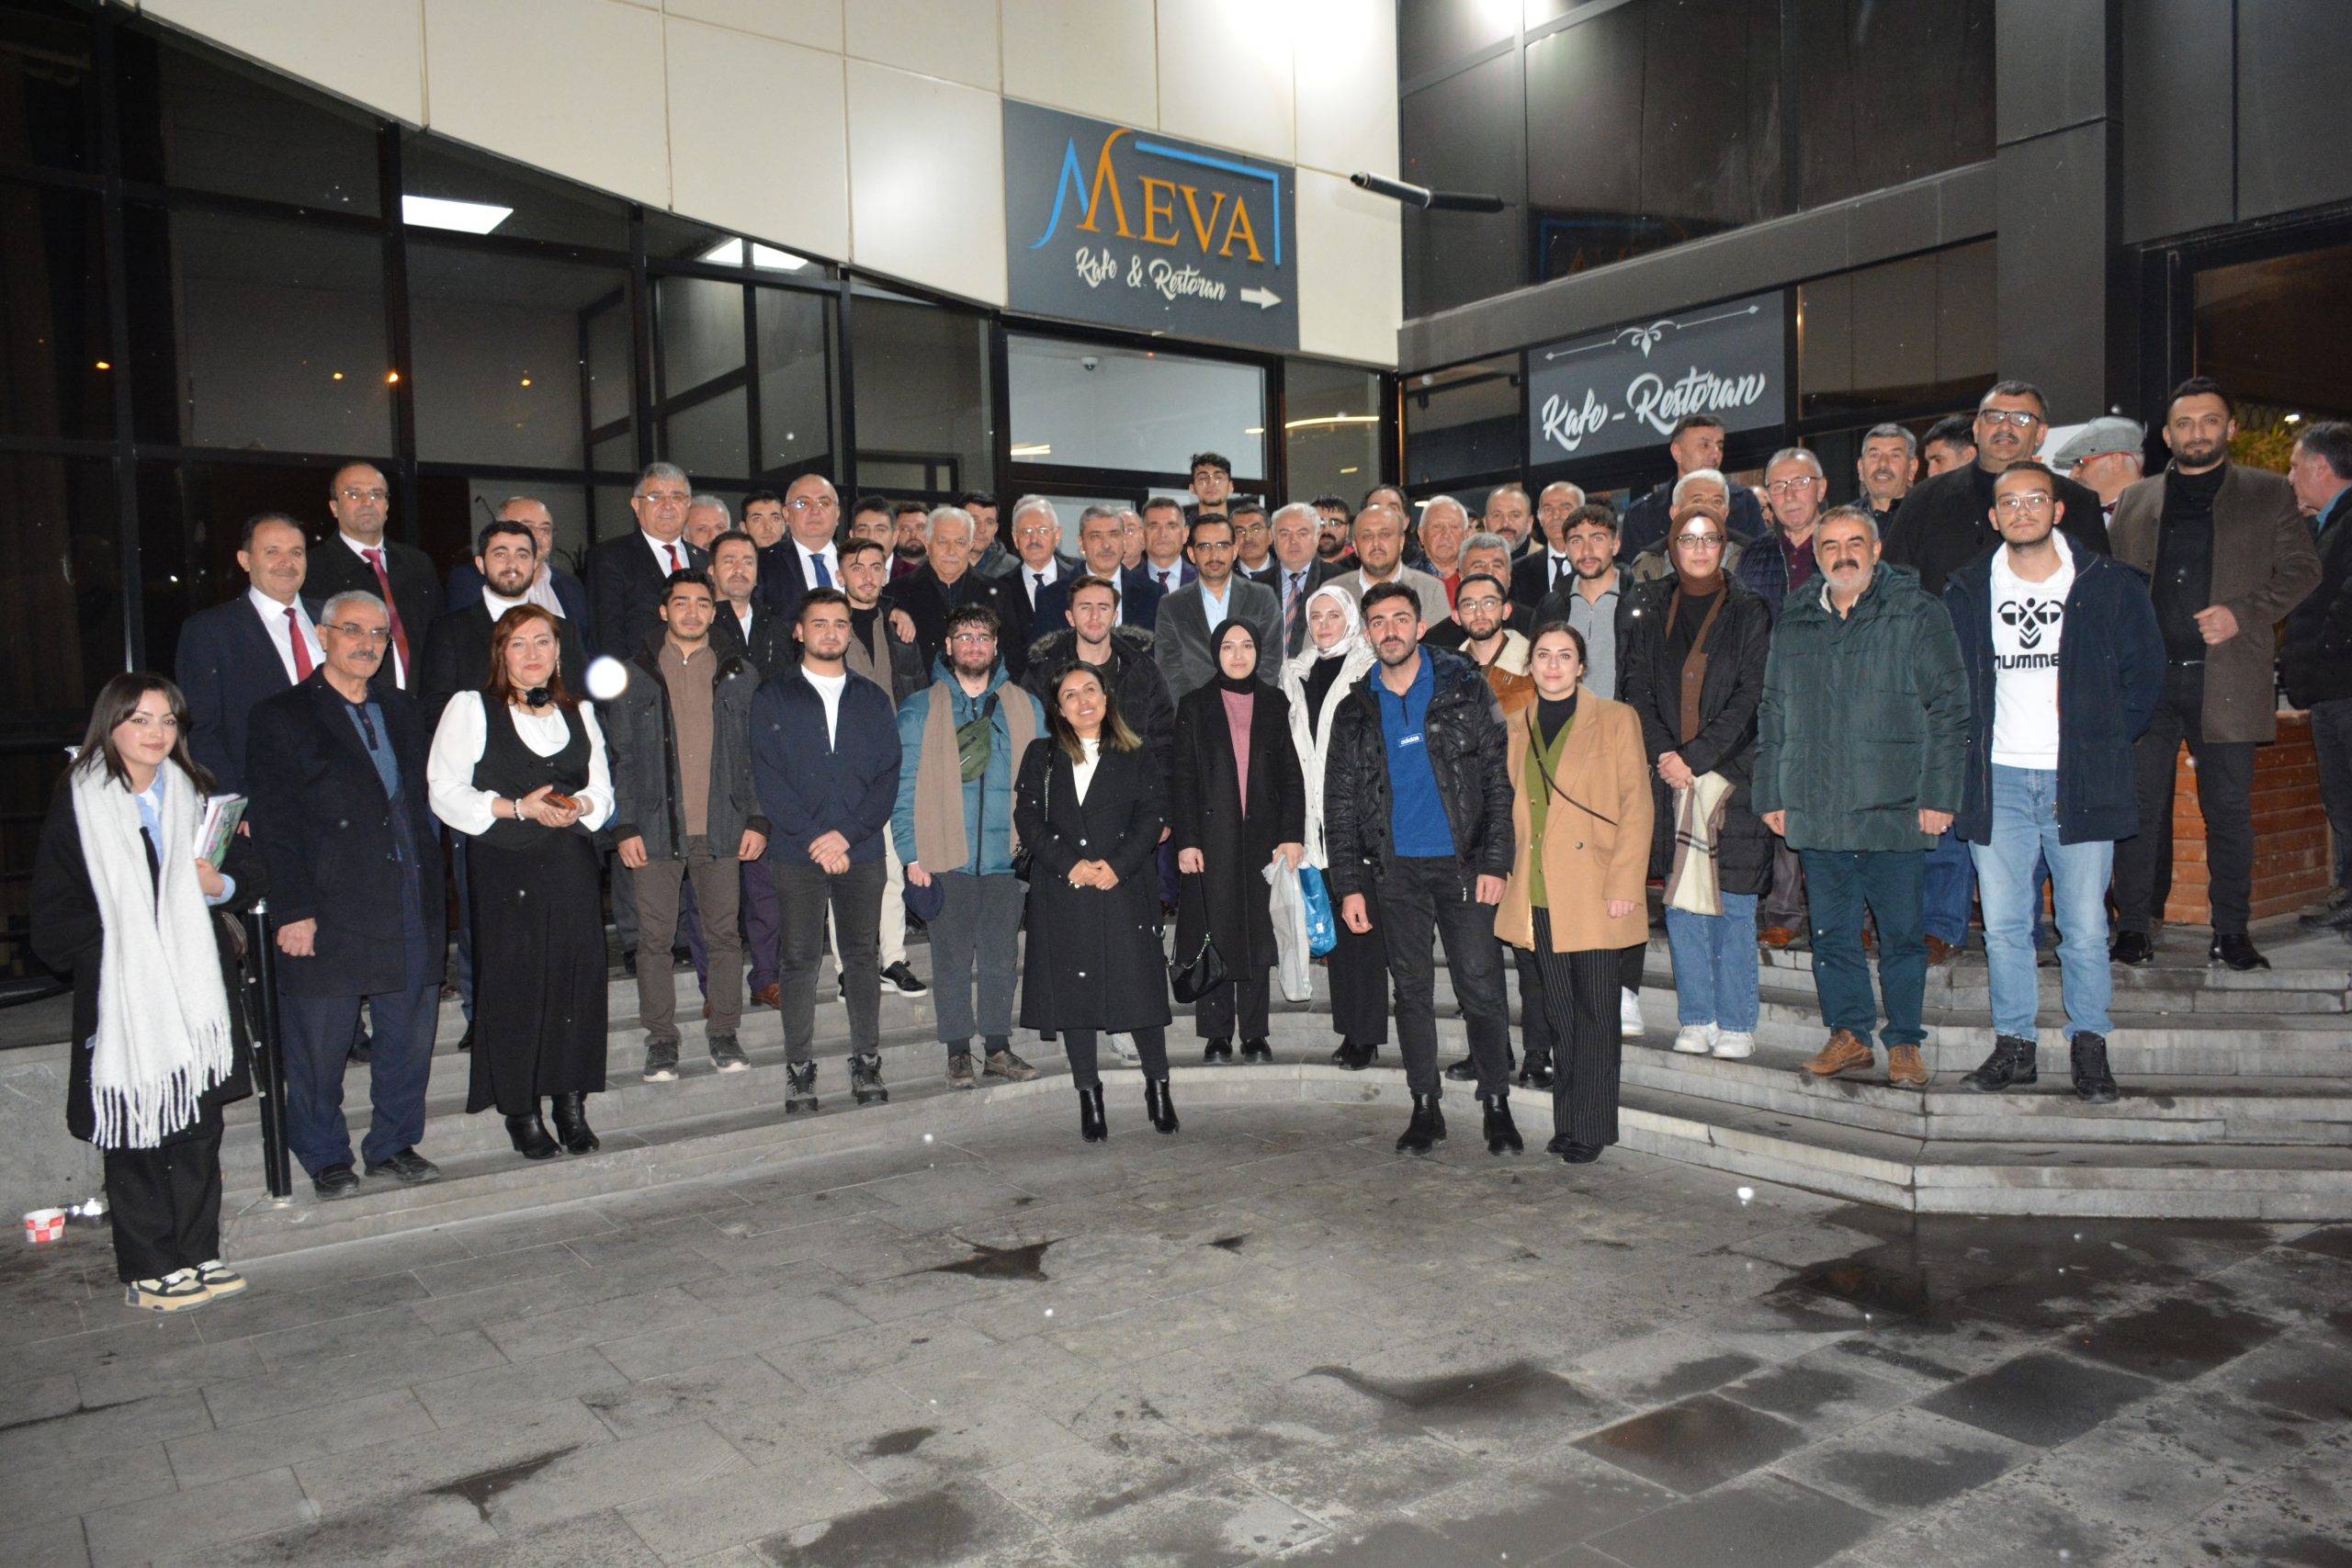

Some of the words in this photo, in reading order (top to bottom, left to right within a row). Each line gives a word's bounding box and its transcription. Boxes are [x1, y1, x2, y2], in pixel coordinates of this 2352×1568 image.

[1030, 128, 1264, 262] MEVA
[1075, 245, 1117, 288] Kafe
[1126, 254, 1143, 288] &
[1148, 259, 1227, 300] Restoran
[1542, 388, 1609, 451] Kafe
[1626, 366, 1766, 435] Restoran
